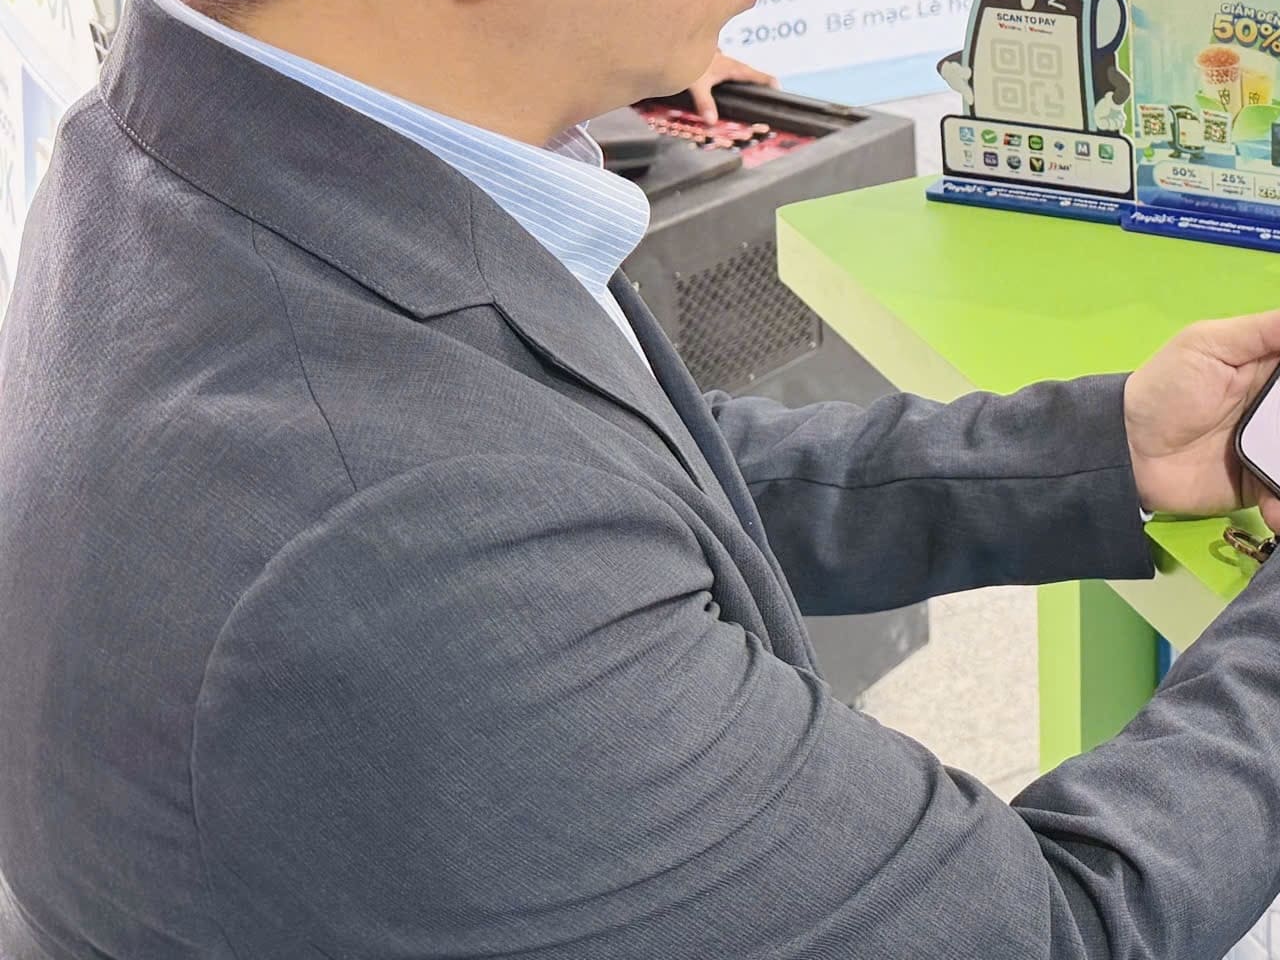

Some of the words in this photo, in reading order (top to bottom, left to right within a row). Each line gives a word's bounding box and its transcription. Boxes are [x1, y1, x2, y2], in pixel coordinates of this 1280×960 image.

[1221, 3, 1256, 19] GIẢM
[997, 12, 1023, 24] SCAN
[1024, 14, 1037, 25] TO
[1038, 16, 1057, 27] PAY
[741, 19, 807, 44] 20:00
